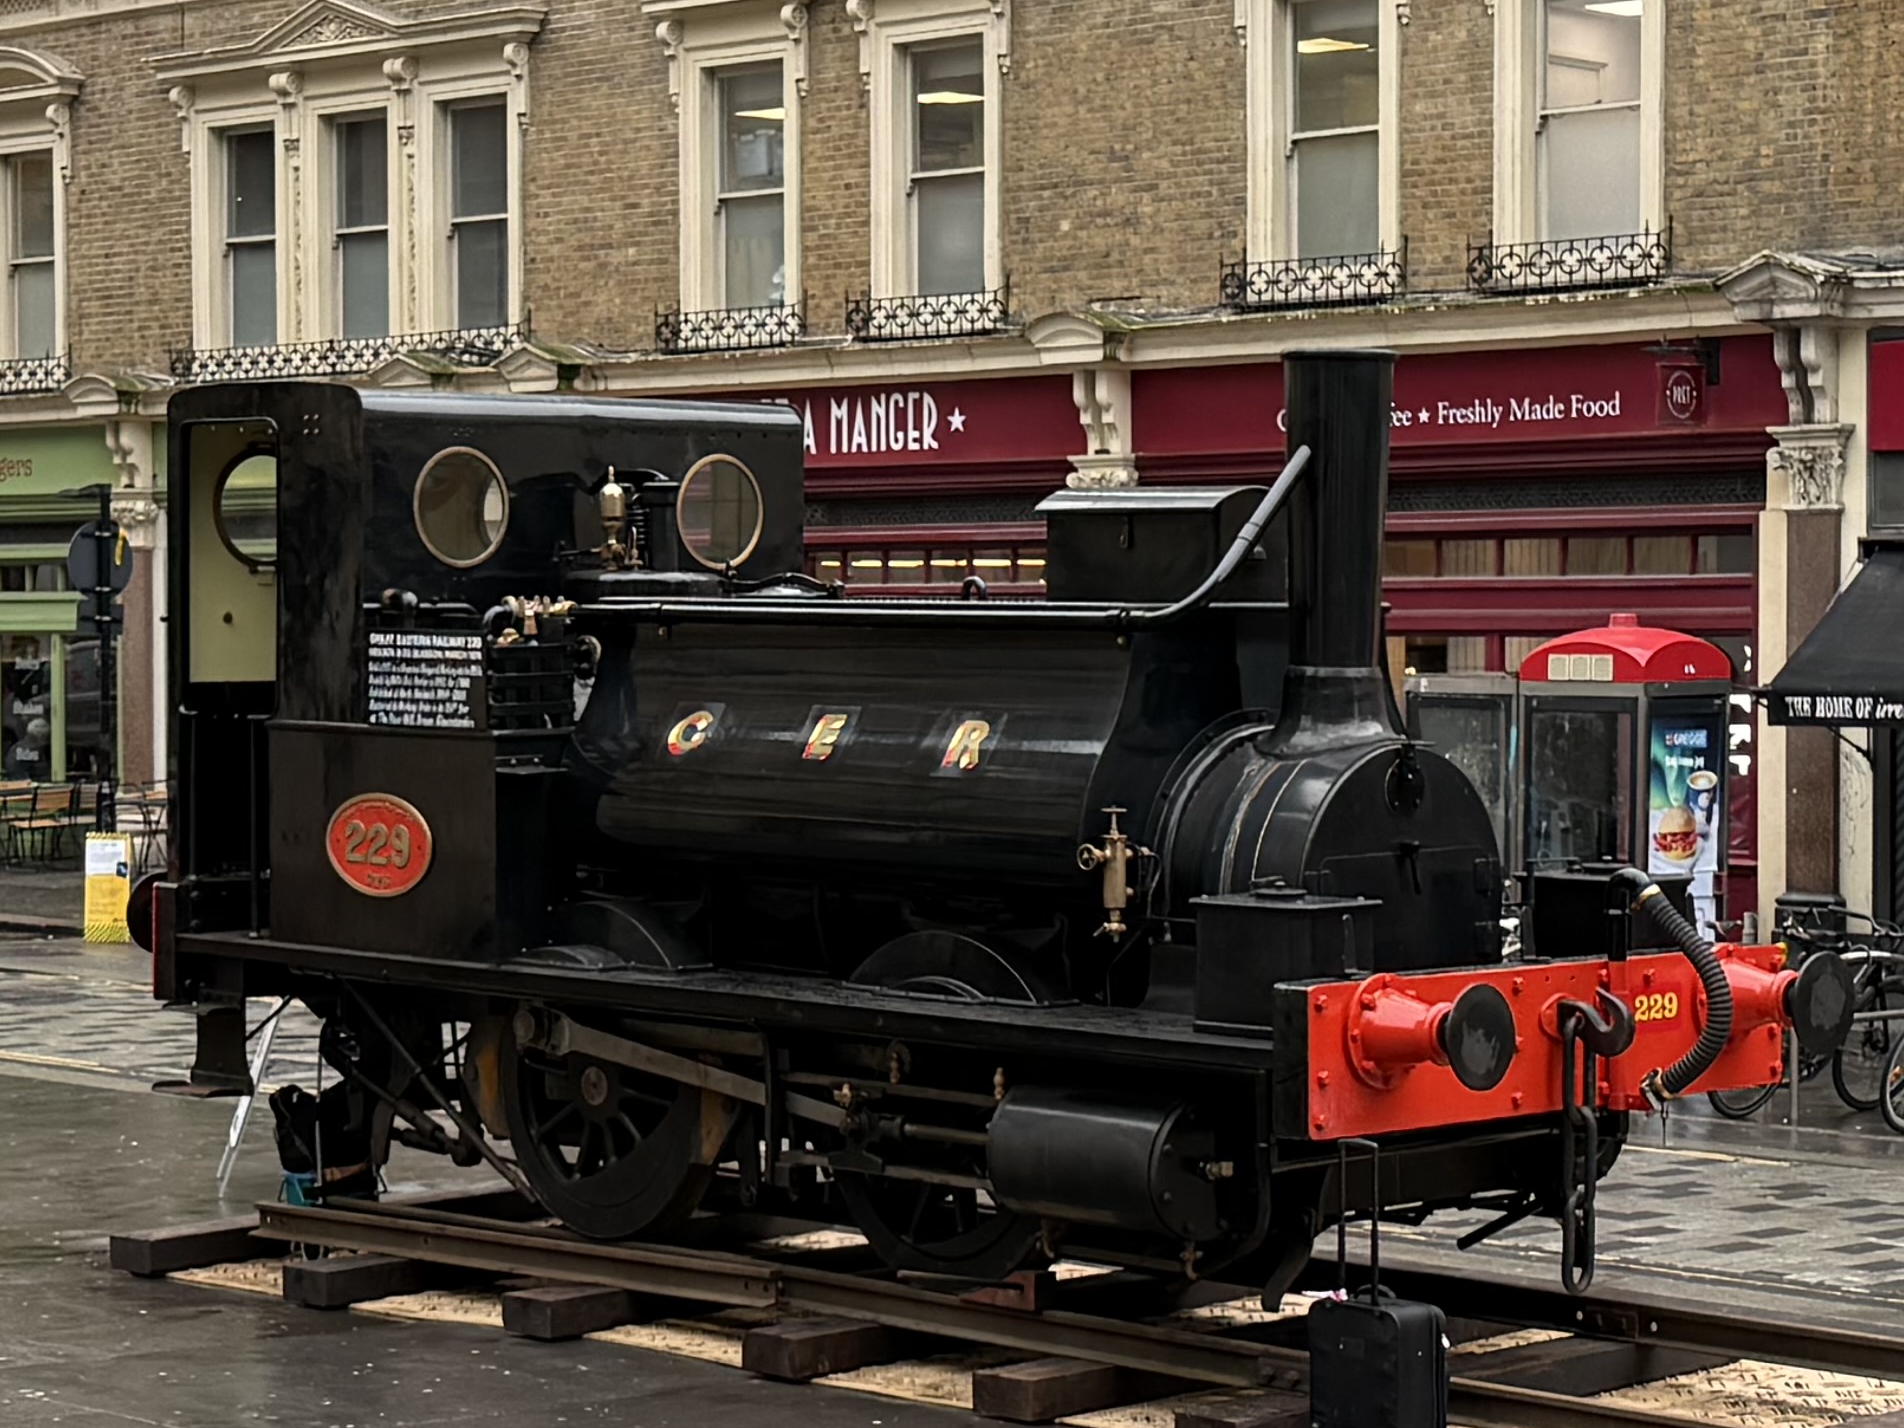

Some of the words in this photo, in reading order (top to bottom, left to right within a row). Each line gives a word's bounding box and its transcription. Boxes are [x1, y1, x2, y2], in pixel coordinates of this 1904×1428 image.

[804, 398, 816, 454] A
[830, 391, 939, 454] MANGER
[1437, 398, 1503, 427] Freshly
[1509, 395, 1564, 421] Made
[1571, 391, 1620, 418] Food
[1785, 696, 1811, 717] THE
[1815, 697, 1853, 718] HOME
[1856, 698, 1873, 719] OF
[802, 714, 847, 760] E
[941, 720, 990, 770] R
[345, 820, 410, 869] 229
[1634, 992, 1678, 1021] 229
